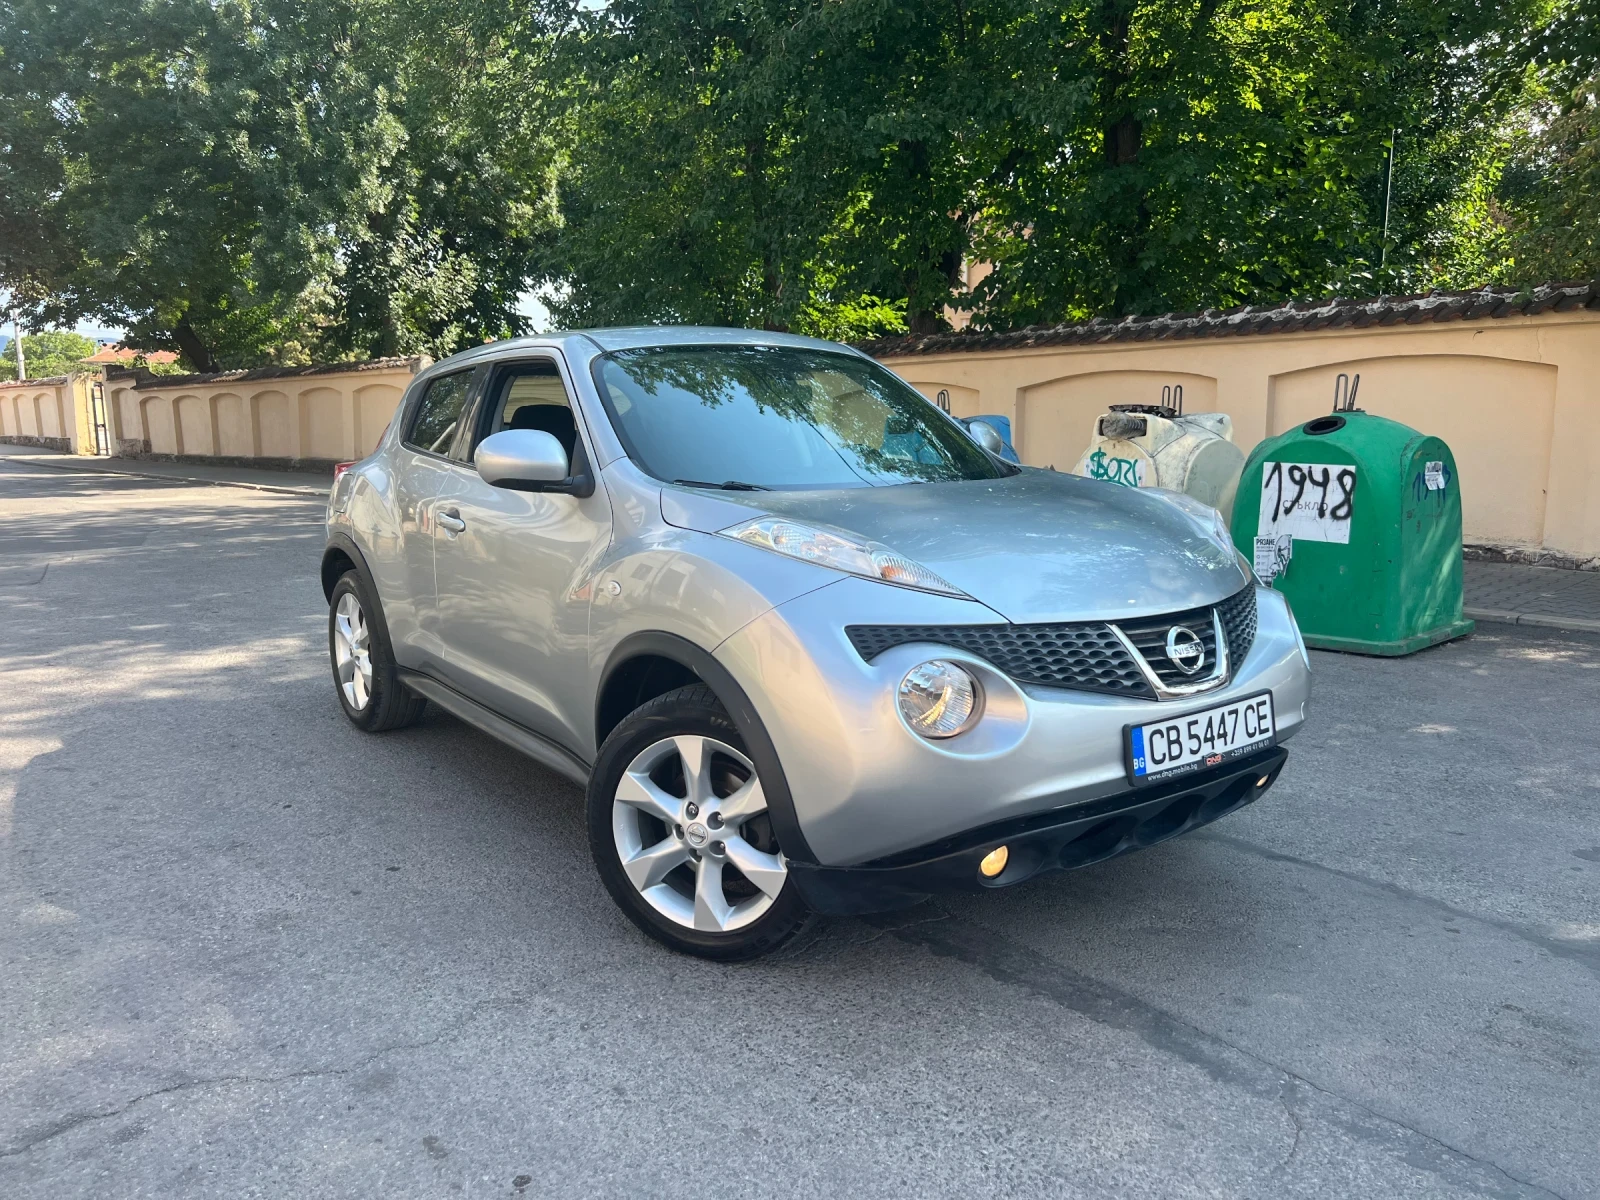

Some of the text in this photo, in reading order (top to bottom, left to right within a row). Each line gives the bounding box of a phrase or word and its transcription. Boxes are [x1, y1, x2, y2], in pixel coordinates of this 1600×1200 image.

[1264, 462, 1356, 522] 1948
[1149, 700, 1270, 765] CB 5447 CE
[1133, 757, 1145, 770] BG
